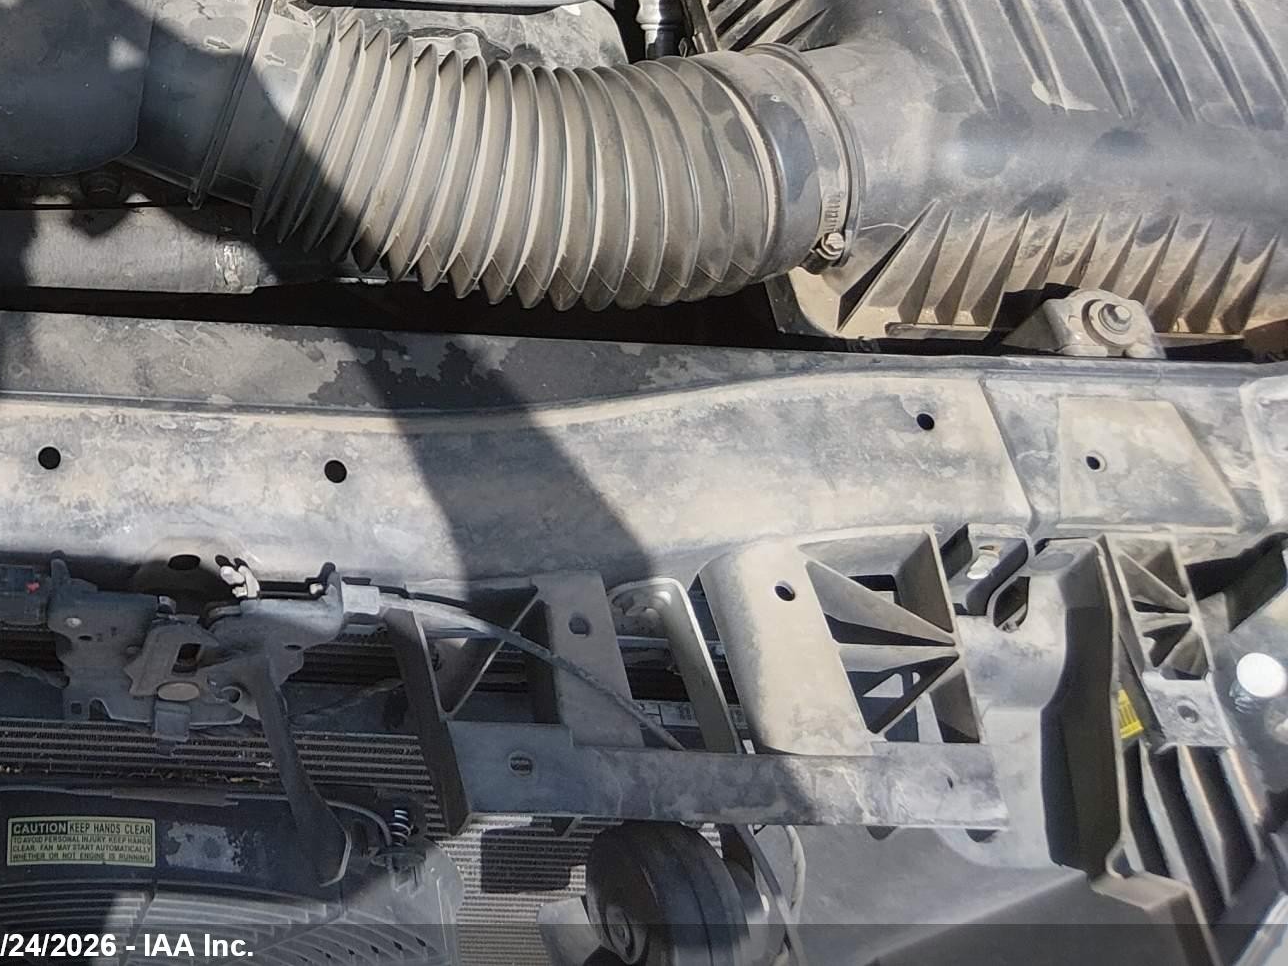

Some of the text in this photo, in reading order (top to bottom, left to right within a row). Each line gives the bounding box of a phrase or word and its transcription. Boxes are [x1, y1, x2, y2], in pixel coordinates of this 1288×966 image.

[13, 822, 151, 835] CAUTION KEEP HANDS CLEAR
